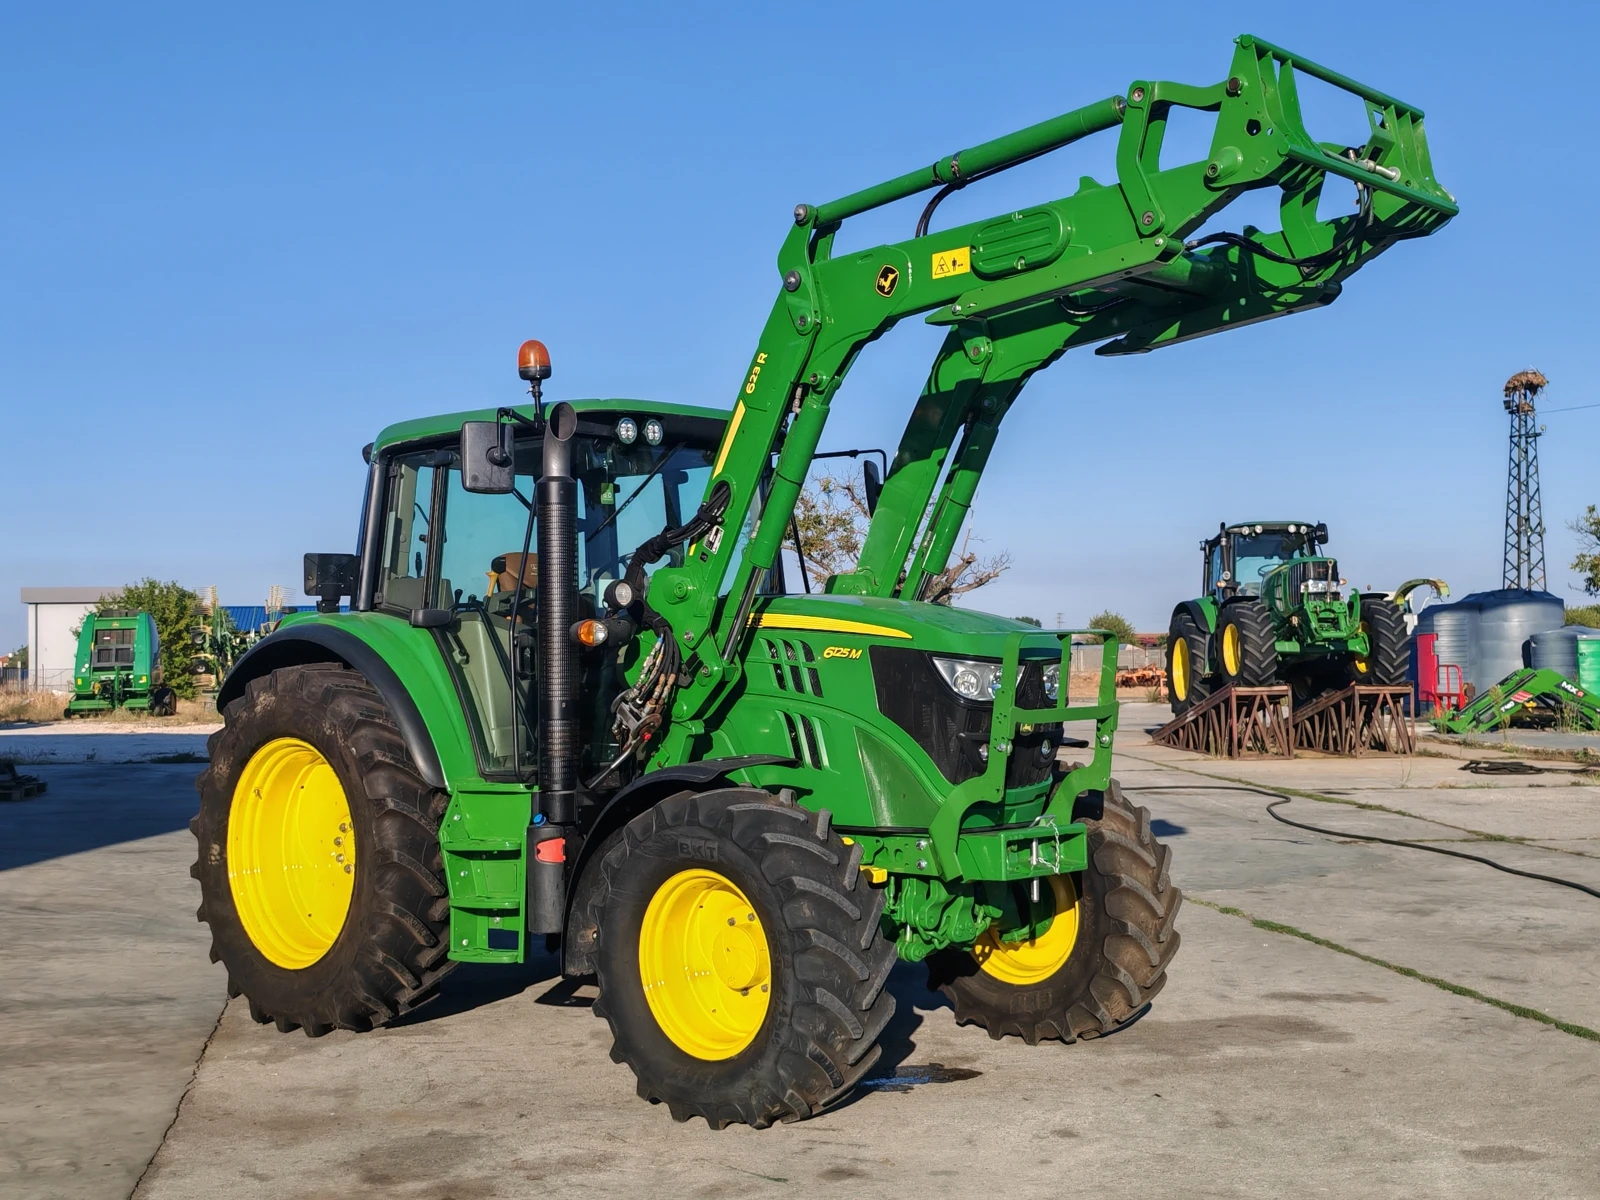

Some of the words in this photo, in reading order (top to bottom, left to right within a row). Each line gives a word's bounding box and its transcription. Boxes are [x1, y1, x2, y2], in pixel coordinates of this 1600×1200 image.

[746, 366, 761, 394] 623
[756, 352, 768, 364] R
[1561, 681, 1579, 695] MX
[678, 840, 719, 862] BKT
